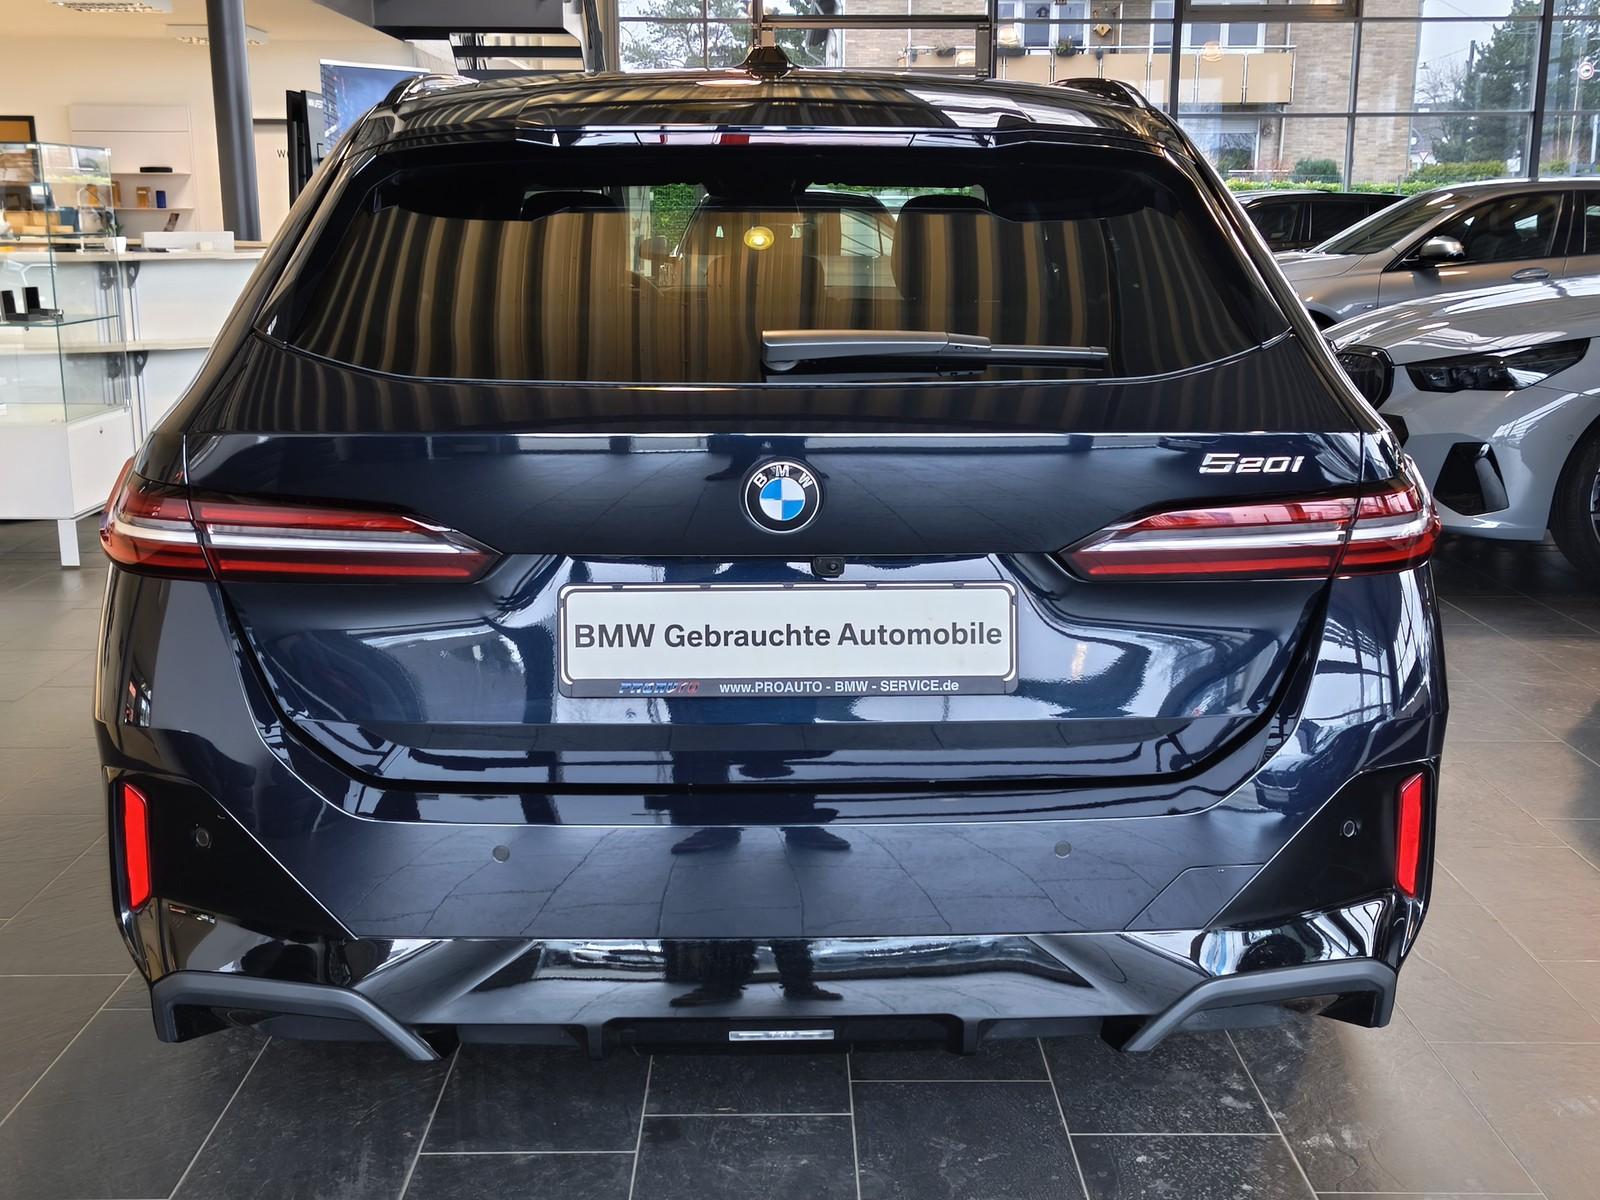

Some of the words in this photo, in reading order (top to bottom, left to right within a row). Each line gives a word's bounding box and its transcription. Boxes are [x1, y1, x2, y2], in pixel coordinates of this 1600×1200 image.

[753, 464, 814, 489] BMW
[575, 623, 655, 648] BMW
[664, 623, 831, 648] Gebrauchte
[837, 621, 1002, 646] Automobile
[719, 680, 823, 693] www.PROAUTO
[834, 680, 869, 693] BMW
[880, 679, 960, 692] SERVICE.de
